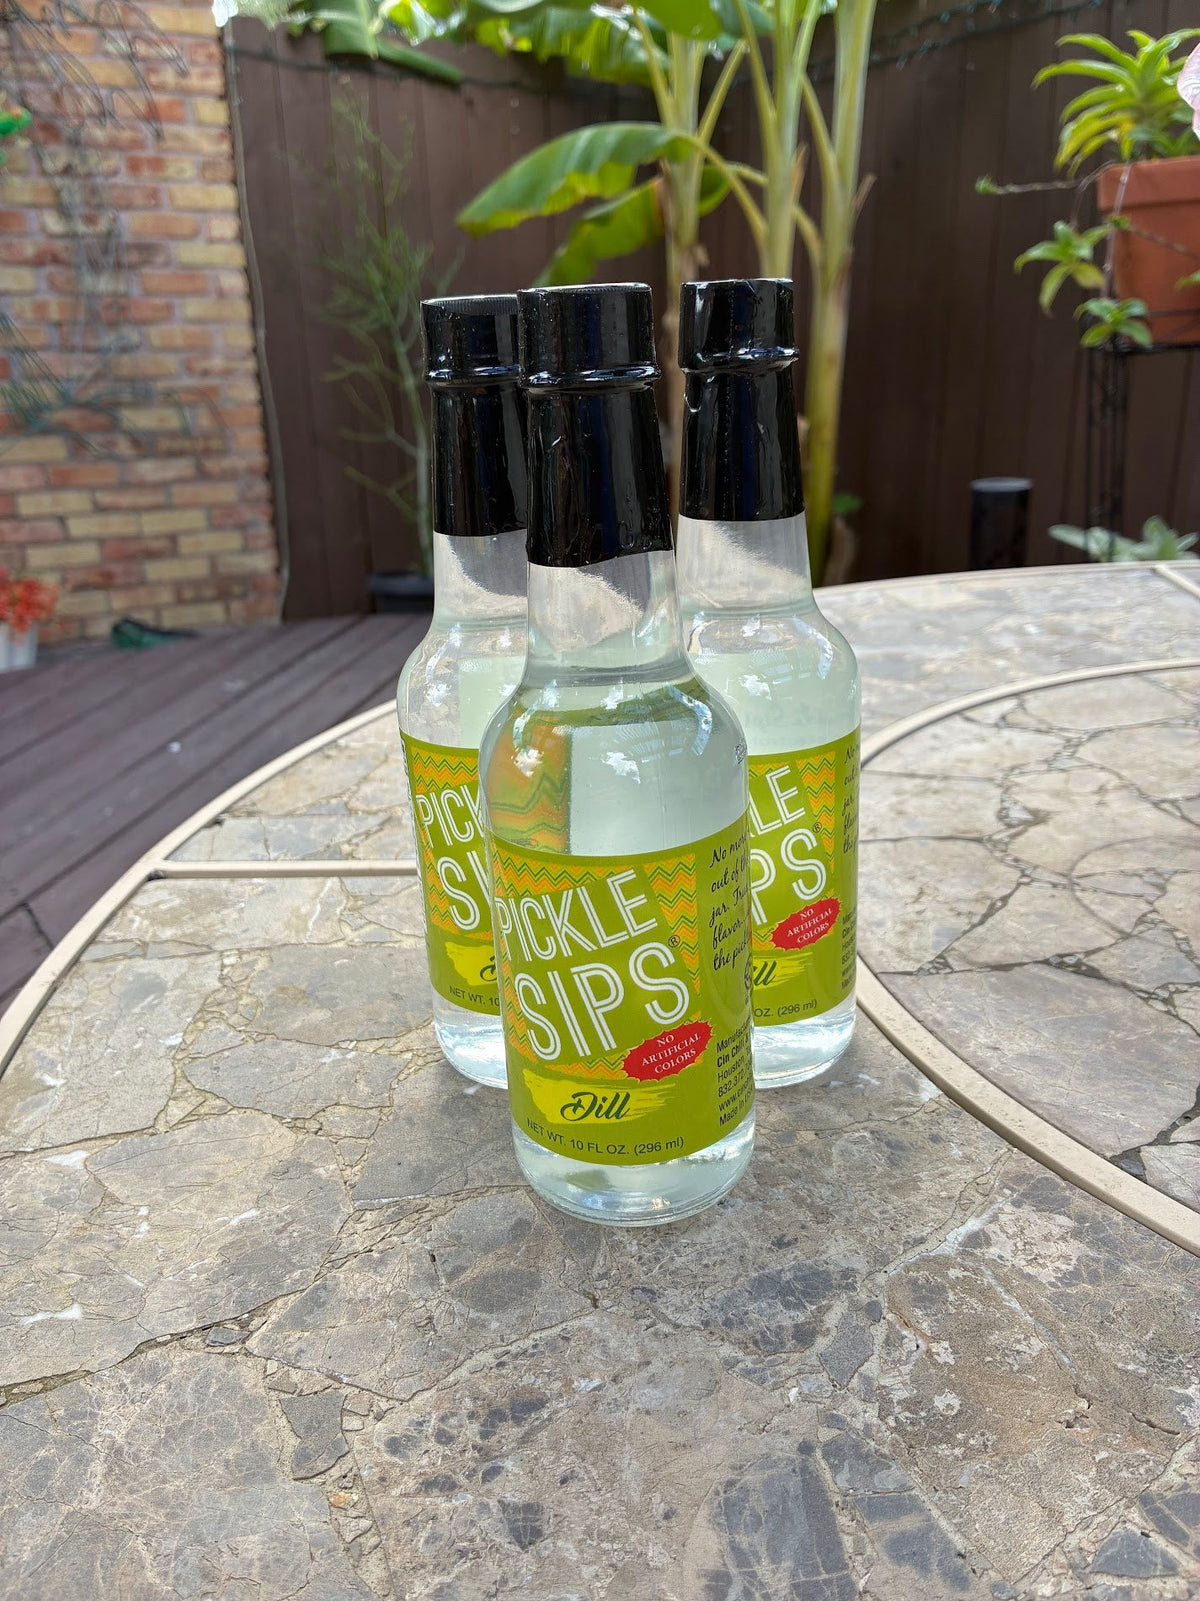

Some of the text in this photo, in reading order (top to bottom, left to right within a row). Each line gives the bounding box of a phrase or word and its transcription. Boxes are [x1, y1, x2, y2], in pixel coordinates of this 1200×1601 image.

[709, 845, 727, 868] No
[711, 867, 729, 893] out
[494, 869, 658, 962] PICKLE
[787, 907, 833, 937] ARTIFICIAL
[800, 907, 814, 920] NO
[796, 921, 830, 944] COLORS
[713, 948, 732, 971] the
[449, 985, 465, 999] NET
[777, 1004, 800, 1018] (296
[803, 999, 817, 1012] ml)
[641, 1033, 702, 1067] ARTIFICIAL
[656, 1033, 675, 1048] NO
[654, 1048, 697, 1075] COLORS
[717, 1053, 730, 1068] Cin
[560, 1091, 631, 1122] Dill
[720, 1106, 738, 1127] Made
[526, 1117, 685, 1157] NET WT. 10 FL OZ. (296 ml)
